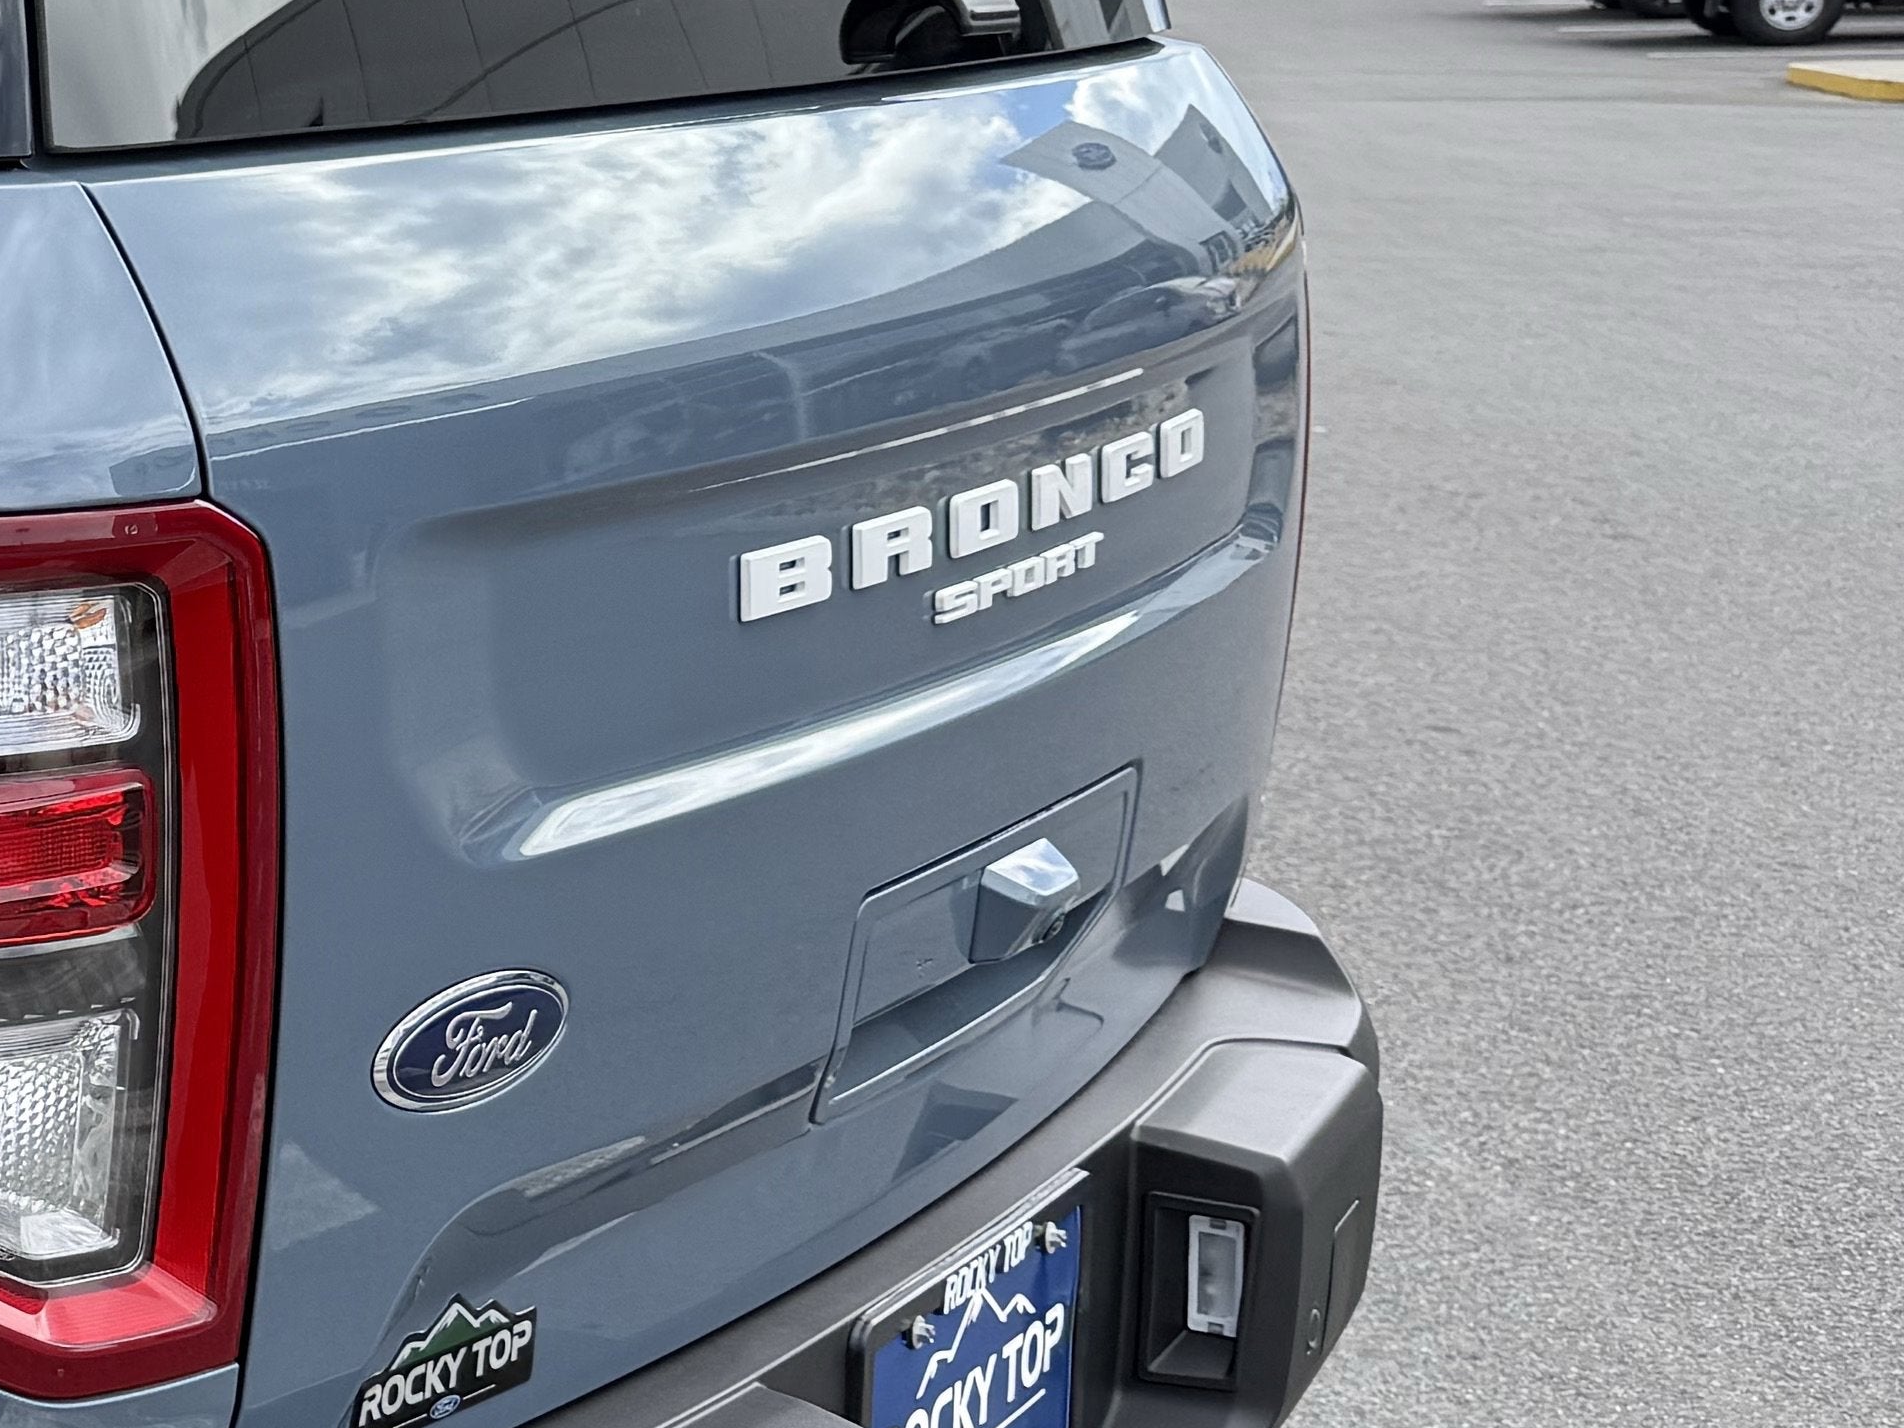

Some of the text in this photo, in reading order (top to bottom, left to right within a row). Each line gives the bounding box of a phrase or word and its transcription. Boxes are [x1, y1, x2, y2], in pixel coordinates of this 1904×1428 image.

[738, 407, 1205, 624] BRONCO
[932, 531, 1105, 625] SPORT
[430, 1000, 539, 1088] Ford
[943, 1221, 1034, 1315] ROCKY TOP
[358, 1319, 533, 1428] ROCKY TOP
[1001, 1302, 1065, 1403] TOP
